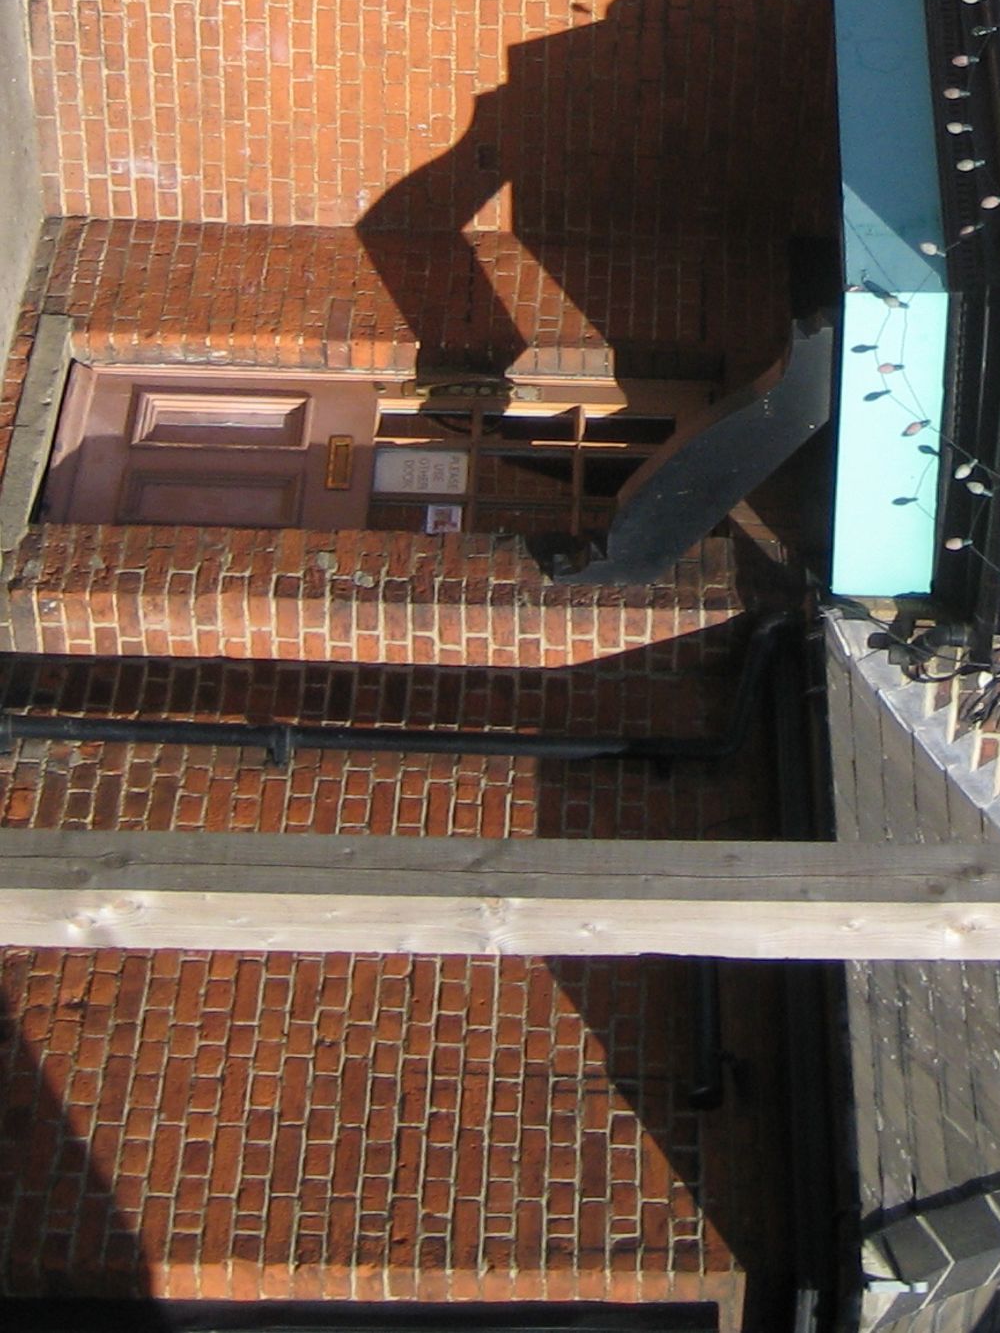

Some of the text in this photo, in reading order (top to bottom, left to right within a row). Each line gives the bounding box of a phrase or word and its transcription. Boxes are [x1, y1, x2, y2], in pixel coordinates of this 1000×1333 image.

[417, 458, 430, 490] OTHER
[432, 463, 445, 482] USE
[448, 456, 461, 489] PLEASE
